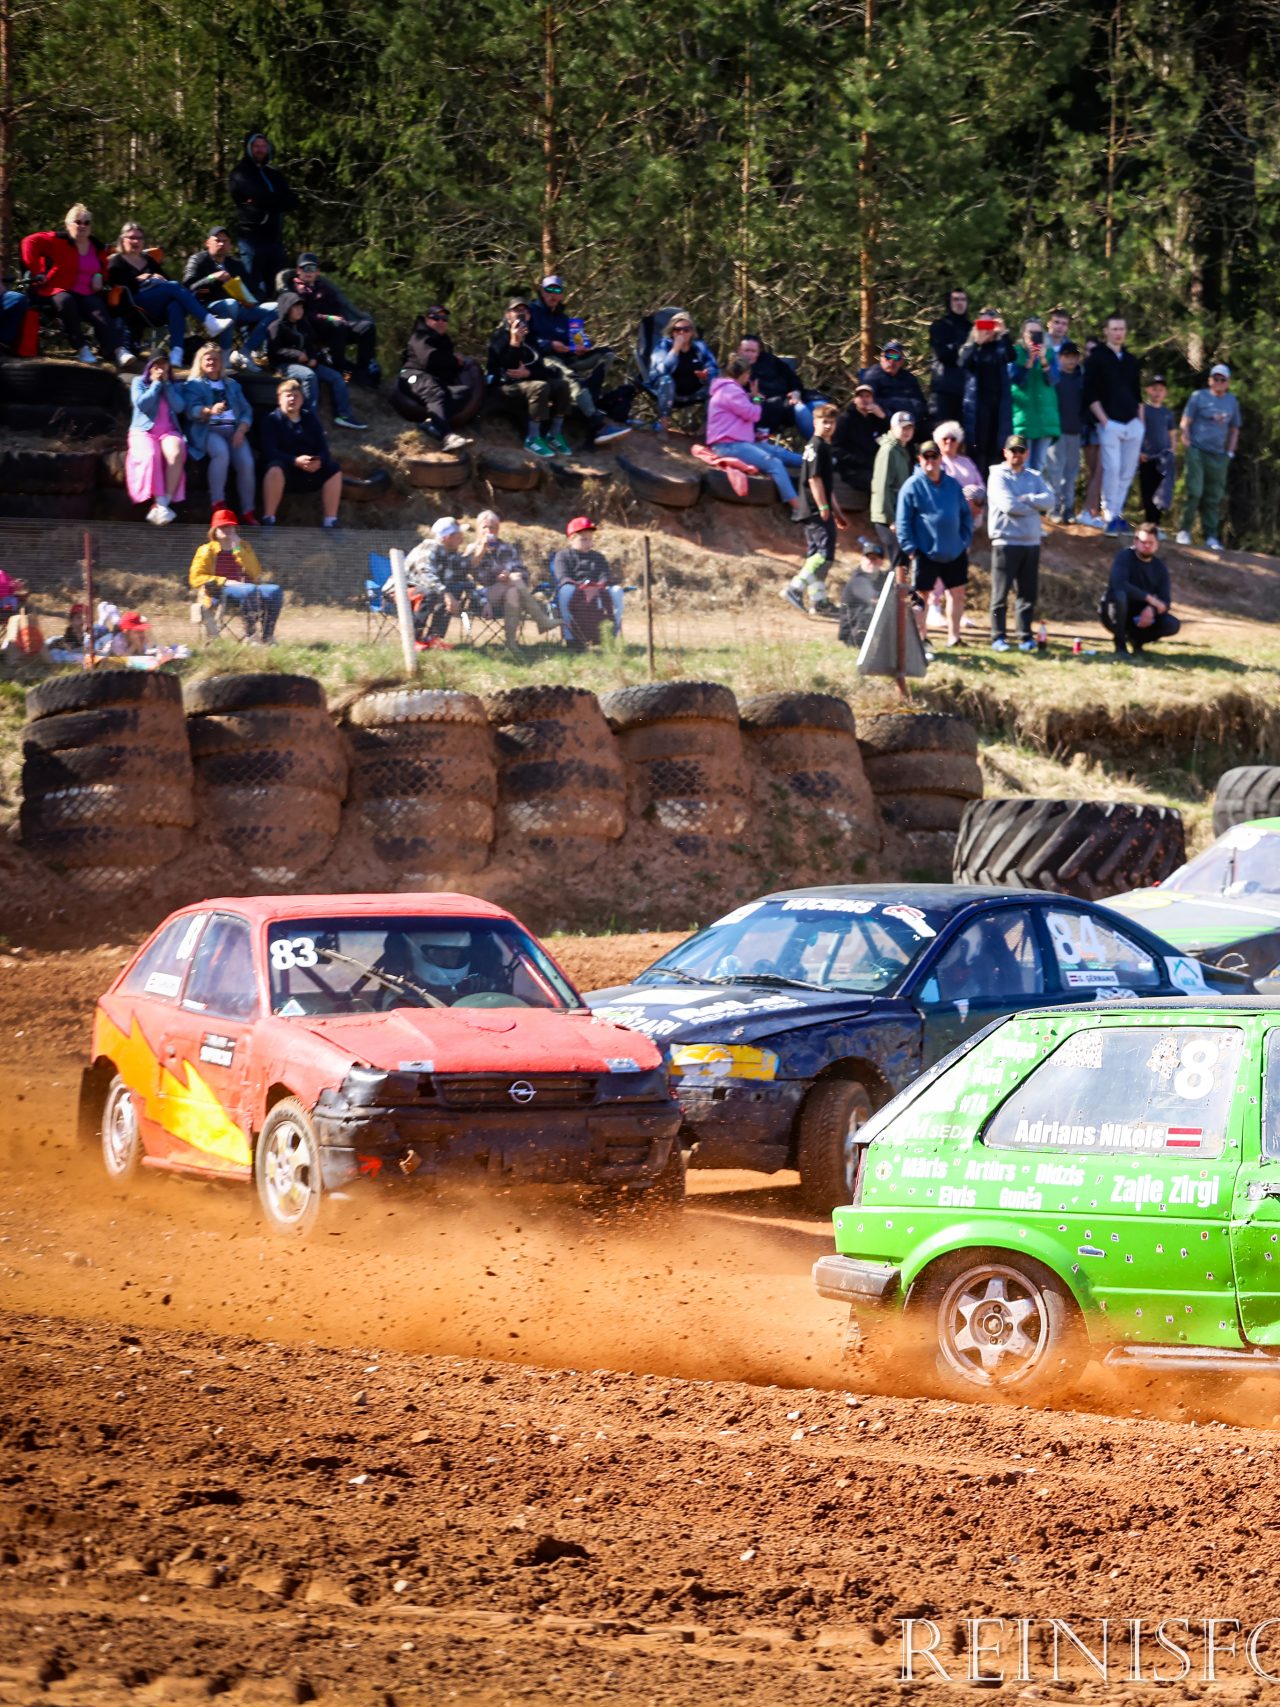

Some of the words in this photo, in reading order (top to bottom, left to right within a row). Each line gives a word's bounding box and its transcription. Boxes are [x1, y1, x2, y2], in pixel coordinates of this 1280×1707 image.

[269, 936, 319, 970] 83
[1045, 911, 1106, 964] 84
[1173, 1039, 1220, 1100] 8
[1014, 1119, 1096, 1146] Adrians
[1168, 1174, 1221, 1208] Zirgi
